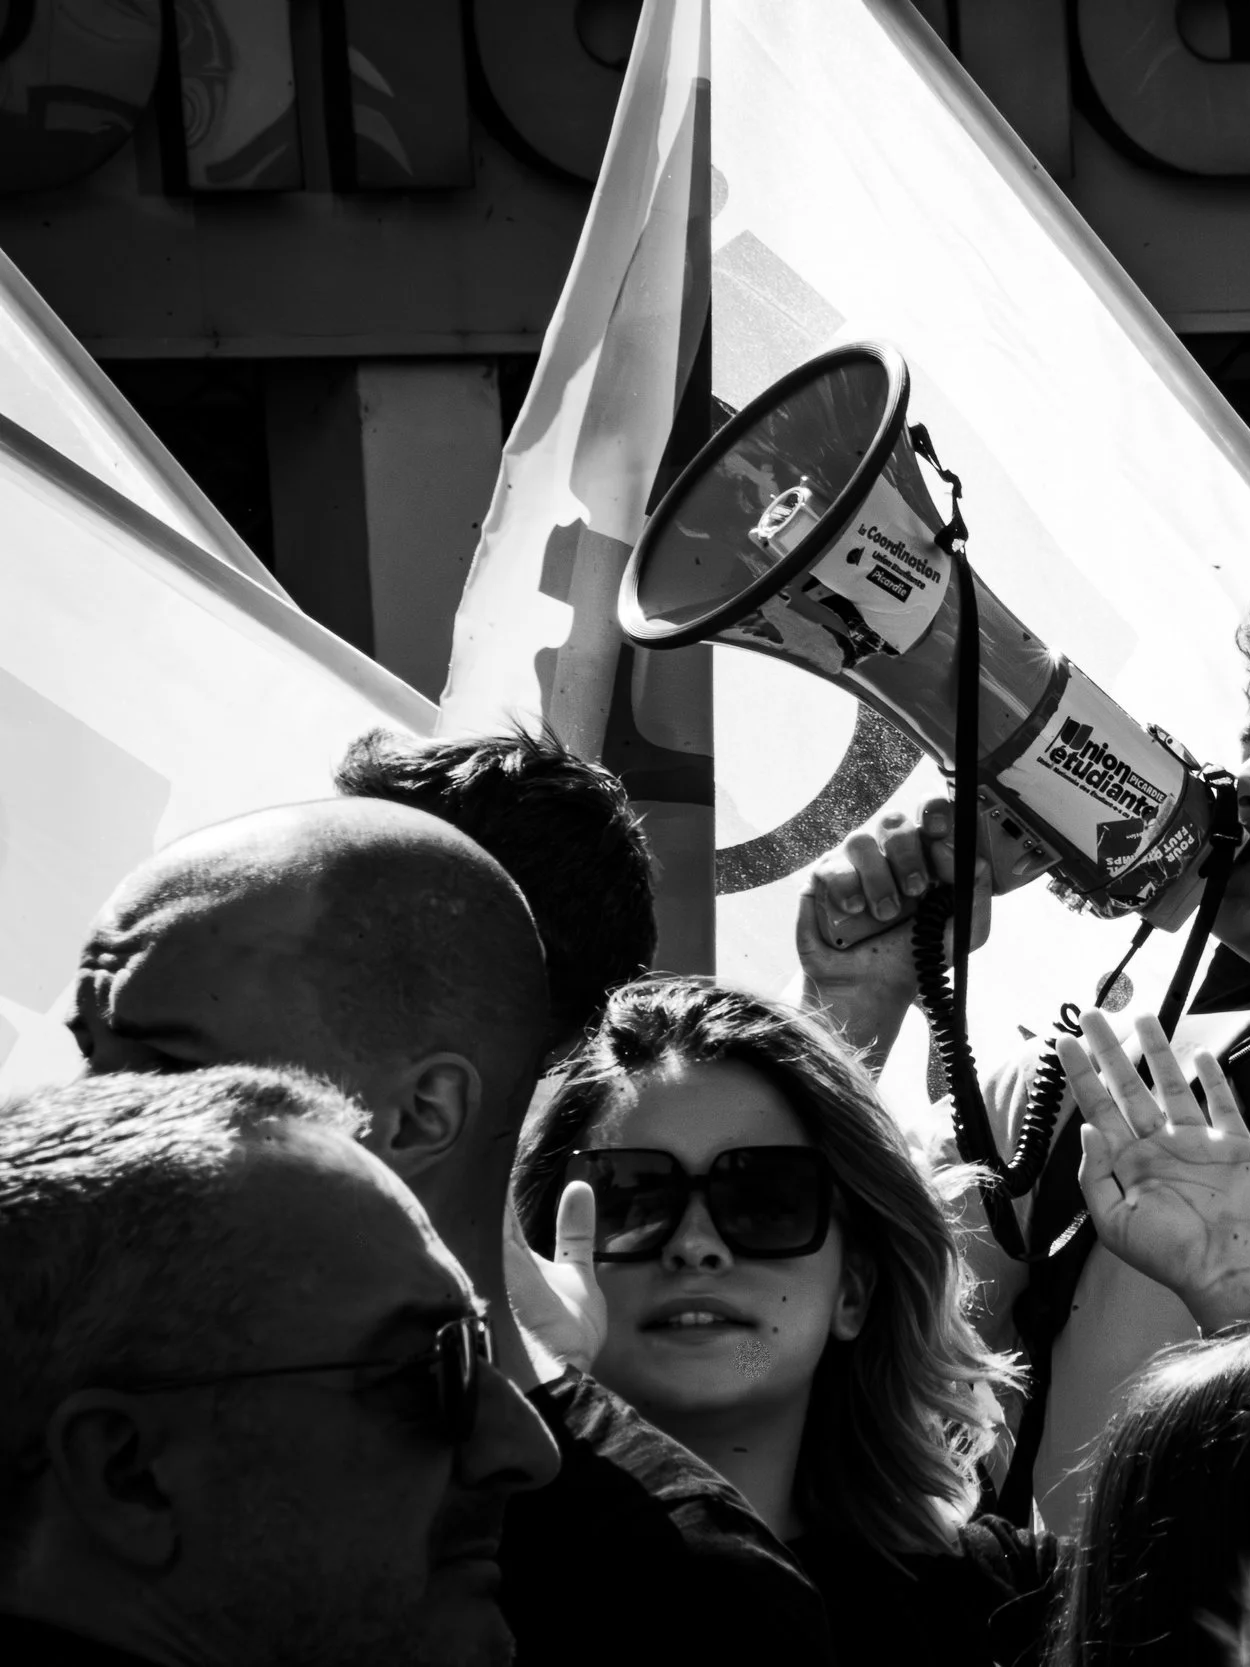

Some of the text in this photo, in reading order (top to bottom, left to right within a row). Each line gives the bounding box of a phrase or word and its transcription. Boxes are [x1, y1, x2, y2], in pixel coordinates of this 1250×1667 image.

[867, 525, 941, 584] Coordination
[871, 569, 907, 597] Picardie
[1060, 718, 1132, 785] Union
[1049, 745, 1159, 821] étudiante
[1129, 775, 1165, 803] PICARDIE
[1163, 825, 1189, 853] FAUT
[1166, 834, 1195, 863] POUR
